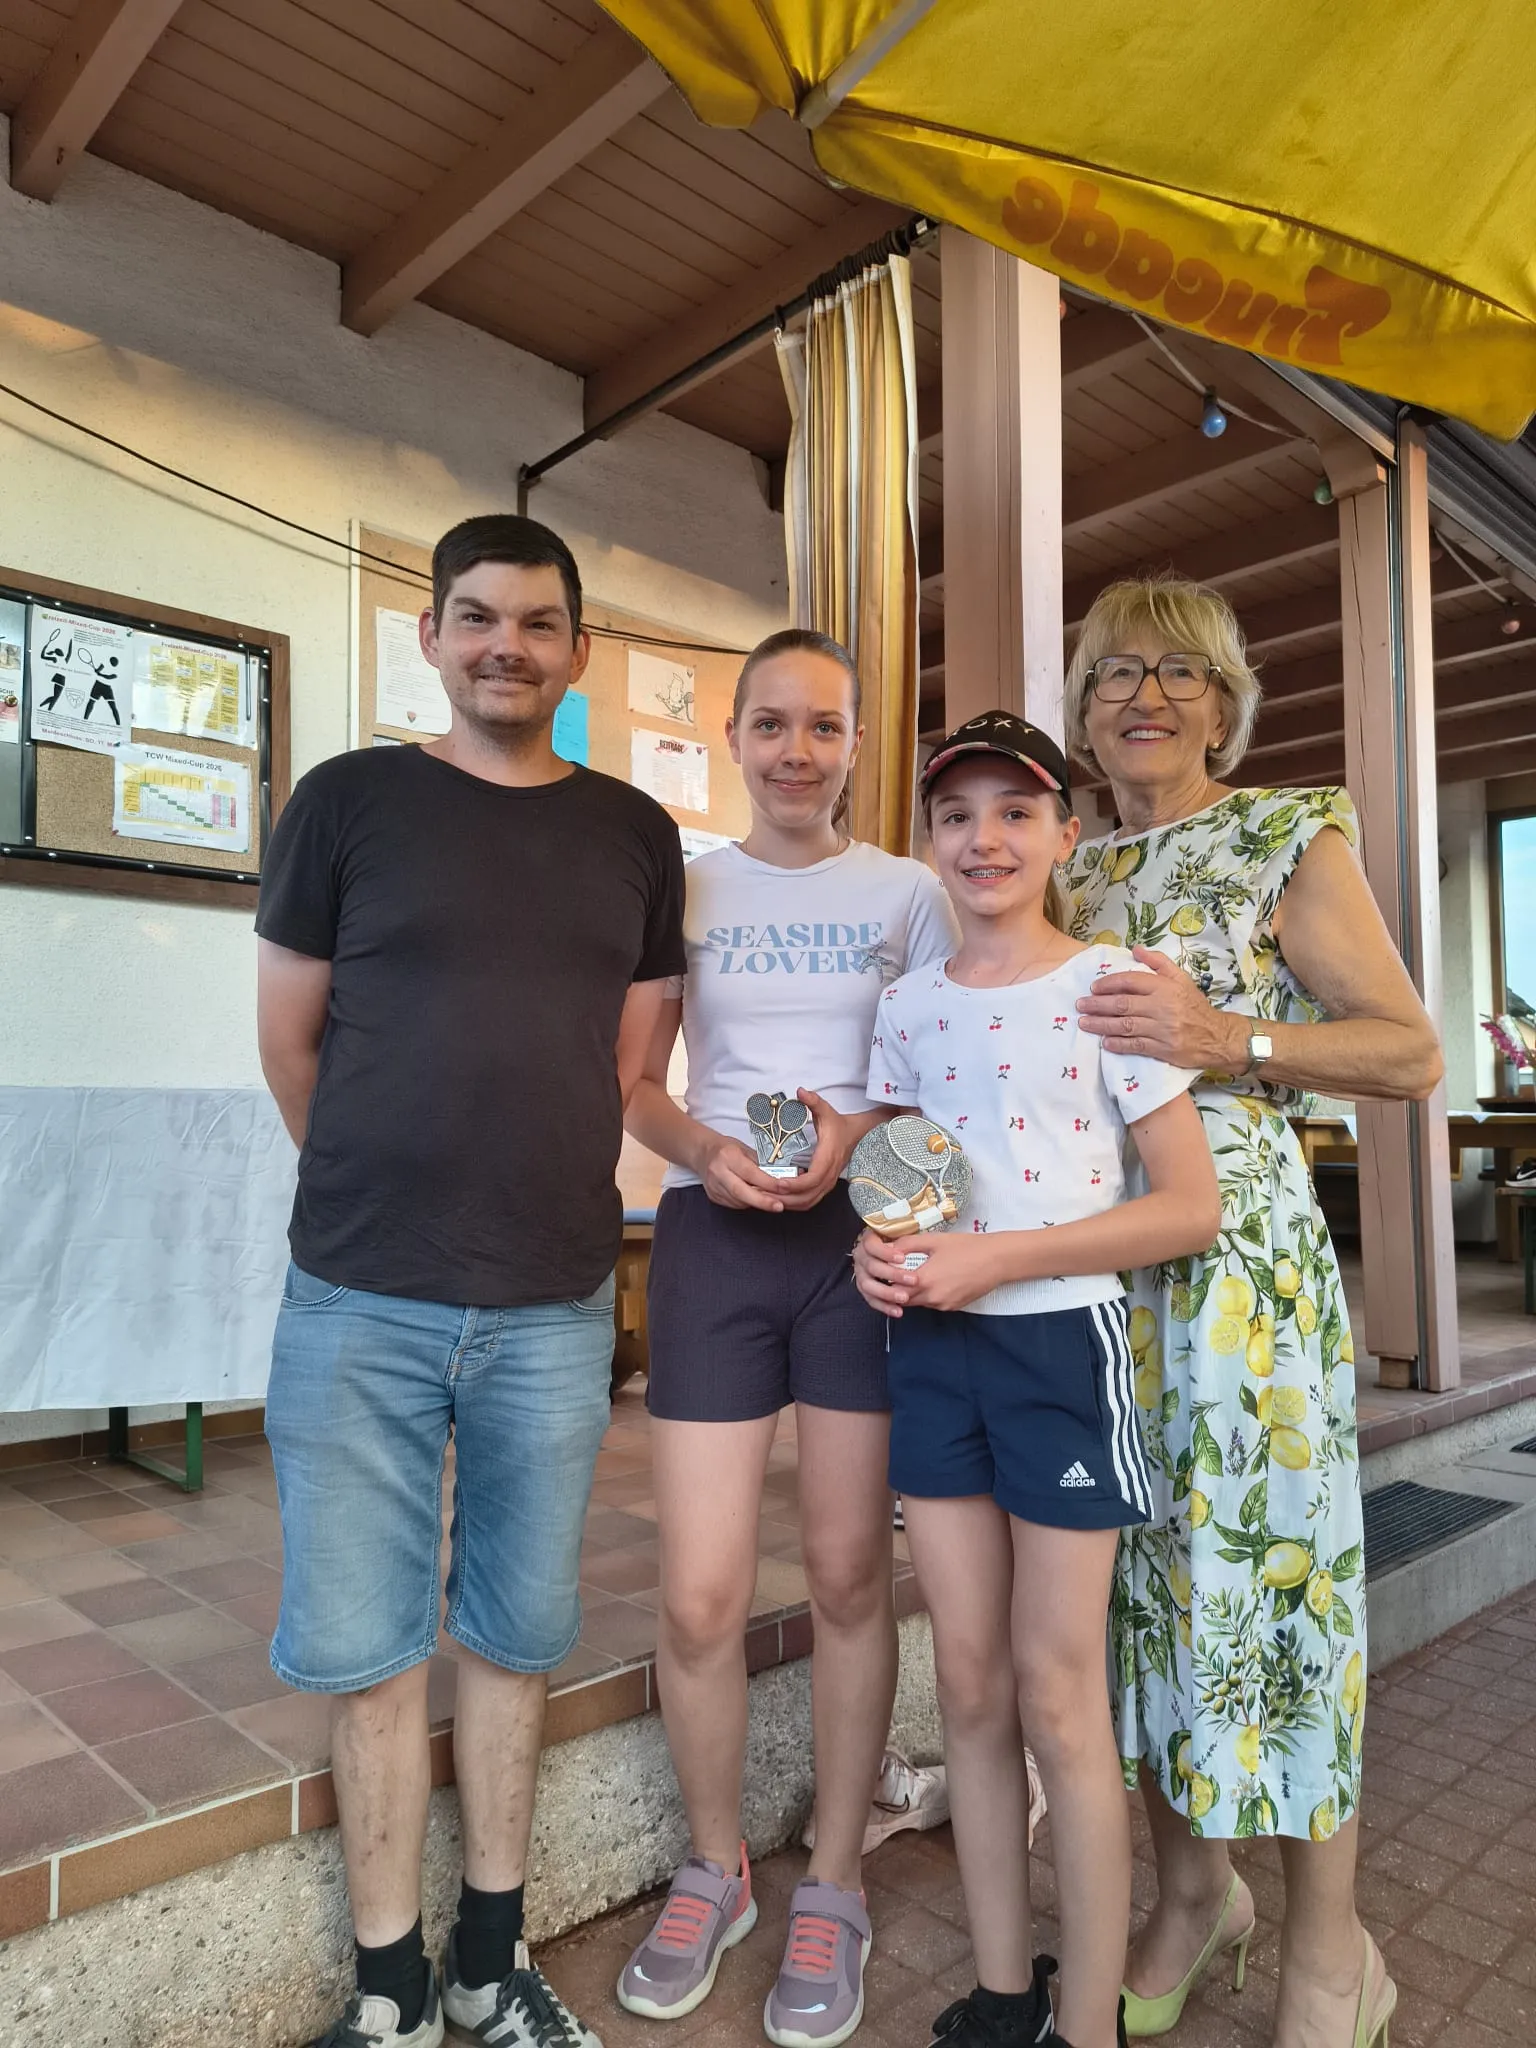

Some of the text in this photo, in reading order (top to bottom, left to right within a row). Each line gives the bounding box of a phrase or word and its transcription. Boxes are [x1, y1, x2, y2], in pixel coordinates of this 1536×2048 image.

[145, 751, 164, 760] TCW
[165, 754, 204, 769] Mixed-Cup
[704, 921, 883, 948] SEASIDE
[1059, 1477, 1096, 1488] adidas
